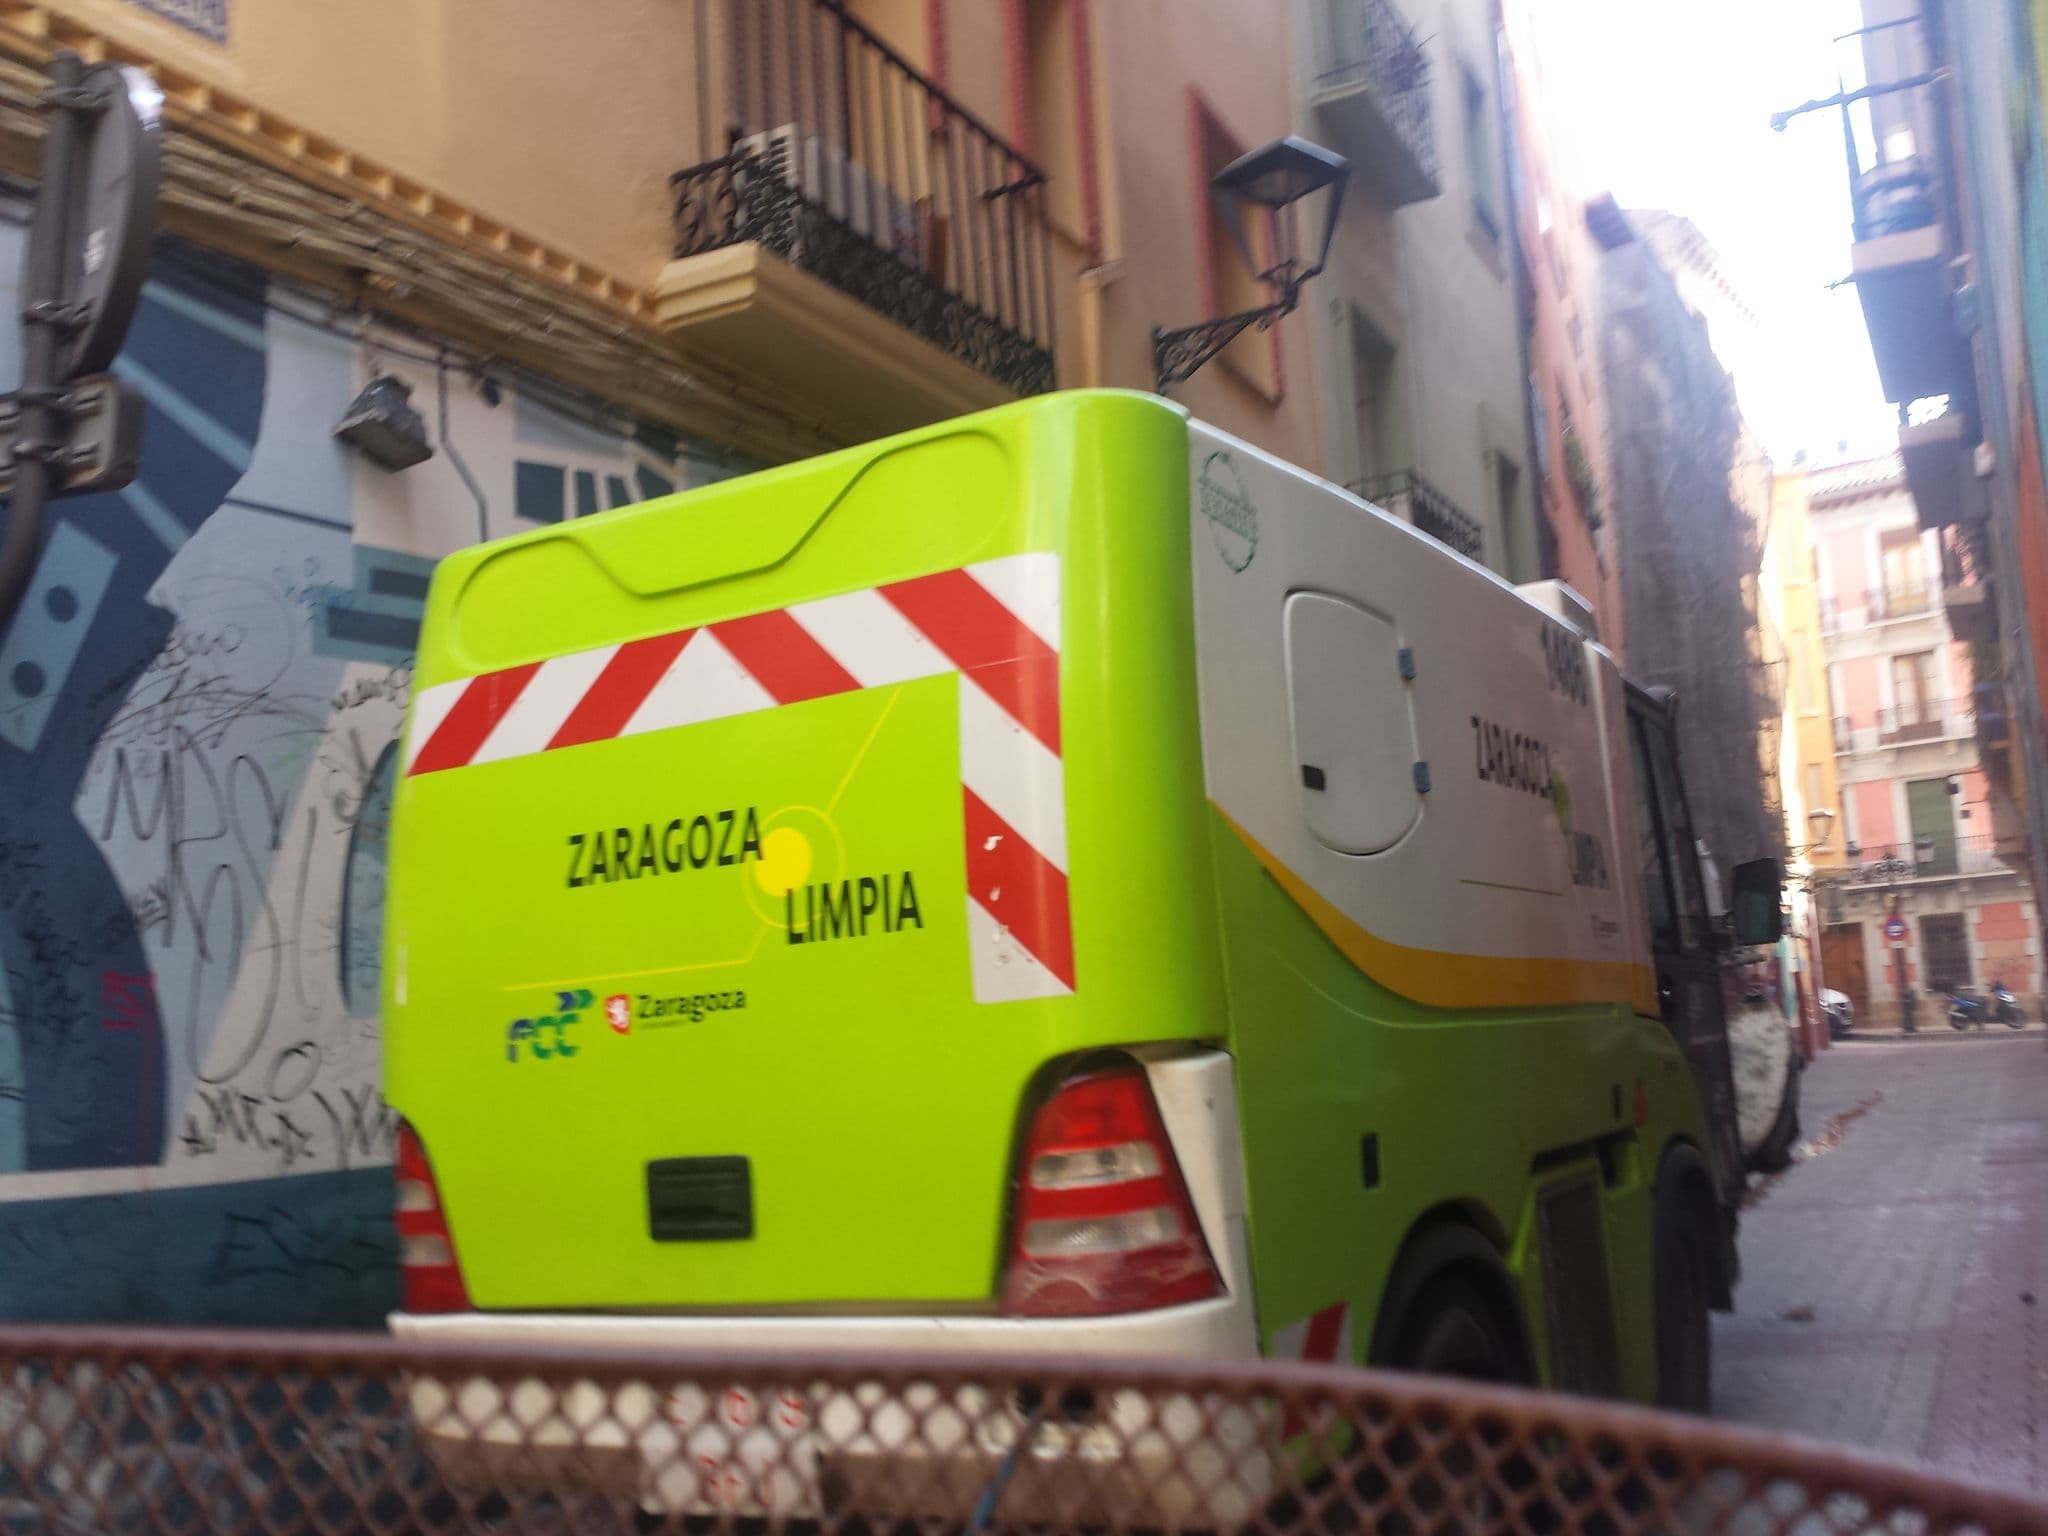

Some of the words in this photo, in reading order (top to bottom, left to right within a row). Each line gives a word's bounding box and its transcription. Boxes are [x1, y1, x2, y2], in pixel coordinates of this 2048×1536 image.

[566, 806, 762, 888] ZARAGOZA
[785, 871, 923, 944] LIMPIA
[637, 990, 747, 1023] Zaragoza
